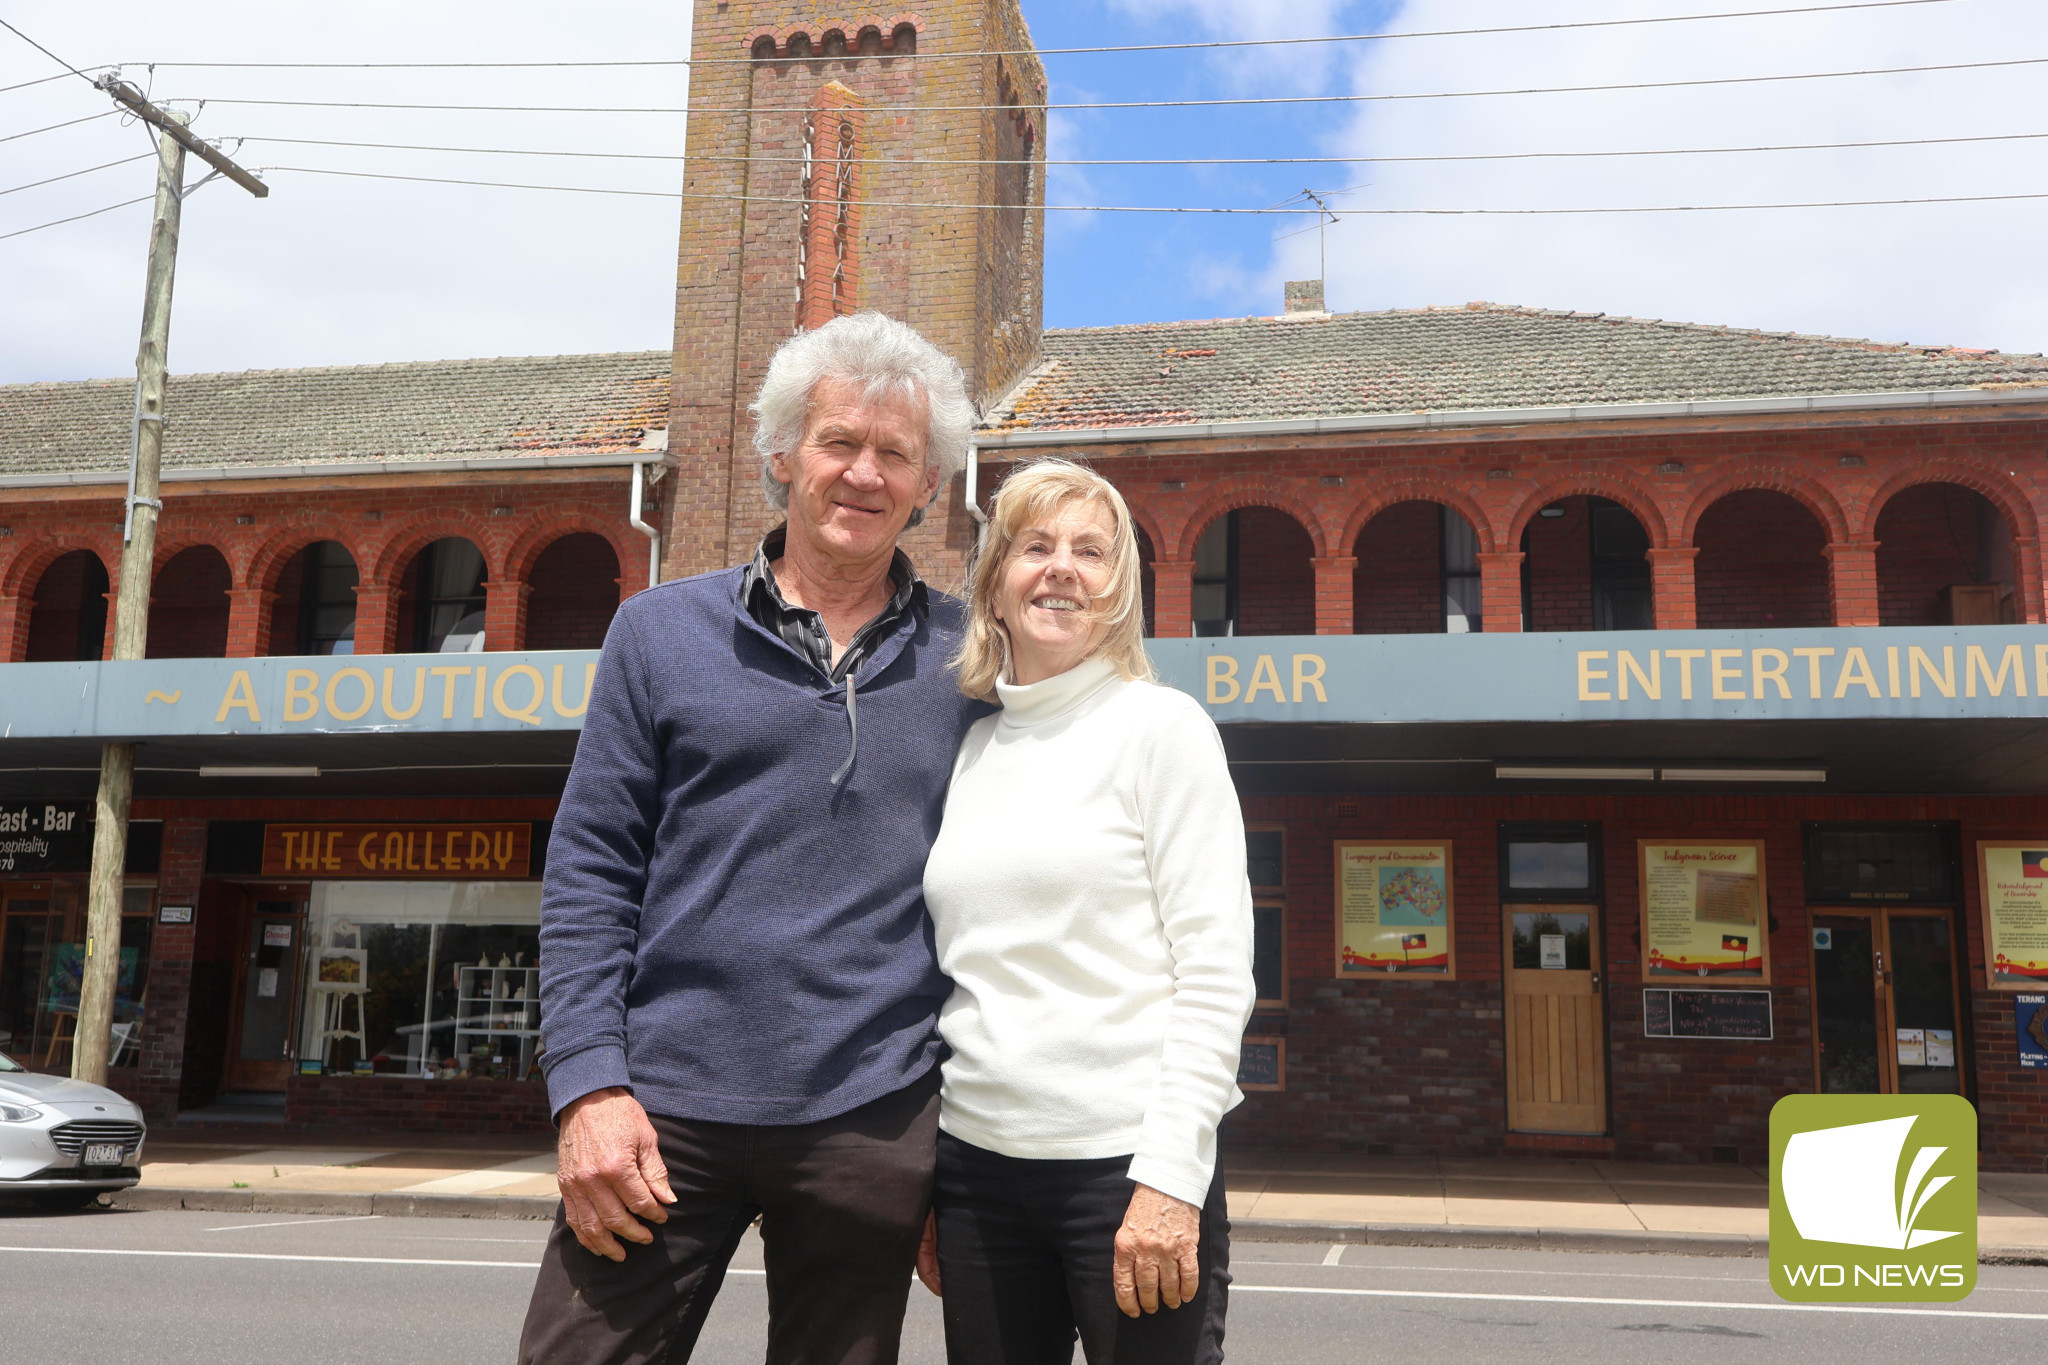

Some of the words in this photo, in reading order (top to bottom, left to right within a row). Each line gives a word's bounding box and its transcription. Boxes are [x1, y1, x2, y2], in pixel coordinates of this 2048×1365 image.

[832, 104, 856, 303] COMMERCIAL
[215, 669, 262, 723] A
[1205, 653, 1329, 705] BAR
[43, 805, 76, 831] Bar
[281, 830, 344, 871] THE
[358, 830, 514, 871] GALLERY
